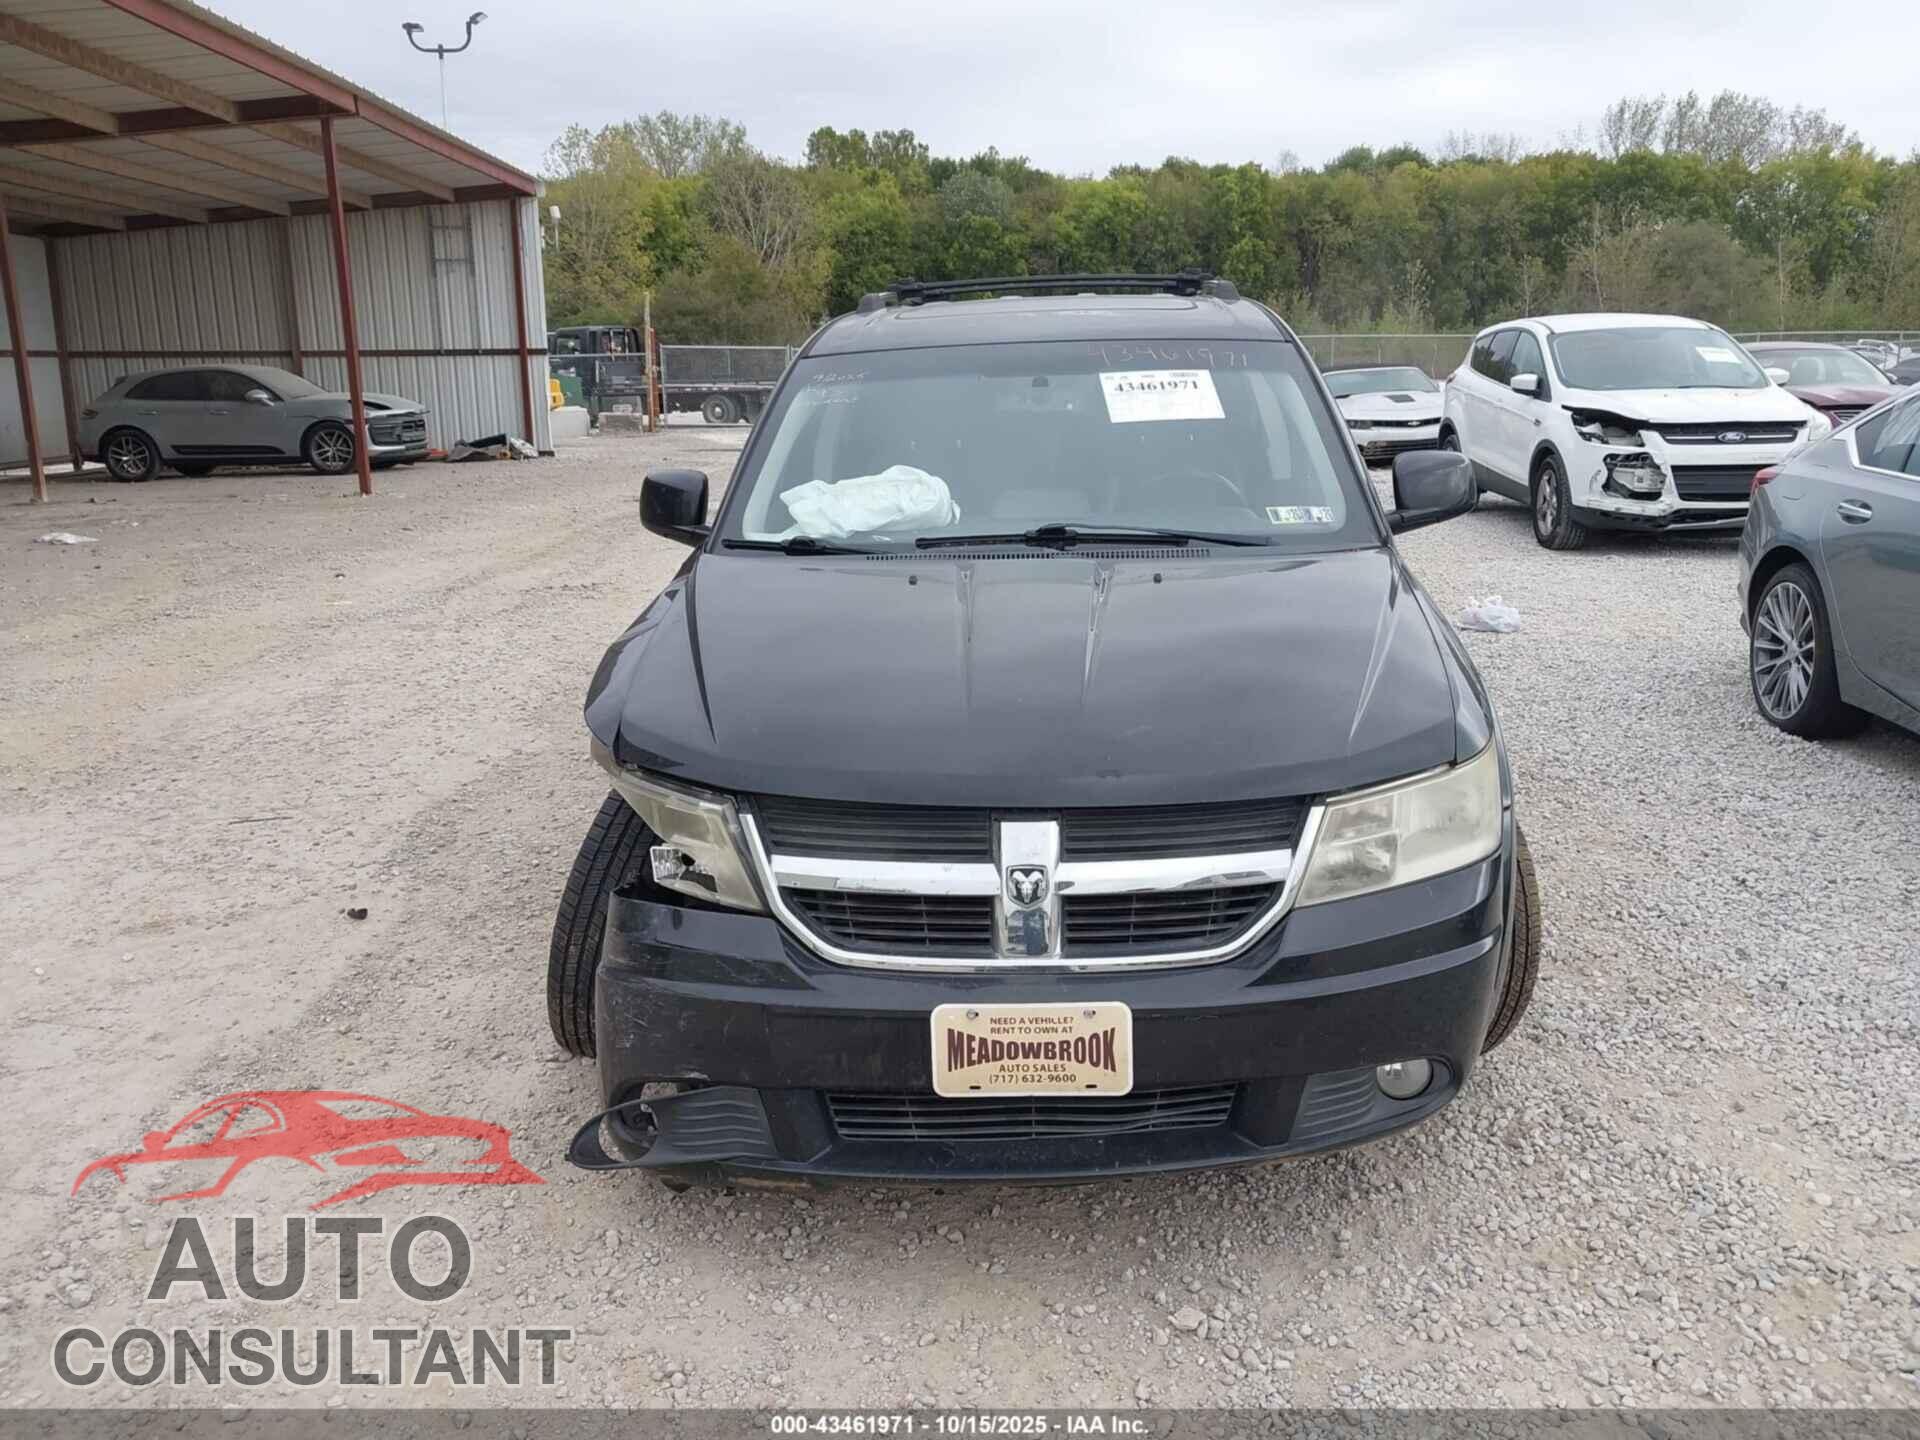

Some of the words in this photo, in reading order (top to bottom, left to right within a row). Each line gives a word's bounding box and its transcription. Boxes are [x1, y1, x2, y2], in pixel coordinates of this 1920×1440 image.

[1115, 380, 1198, 392] 43461971
[990, 1017, 1016, 1025] NEED
[1018, 1017, 1026, 1025] A
[990, 1027, 1016, 1035] RENT
[1034, 1026, 1058, 1034] OWN
[1061, 1026, 1073, 1034] AT
[947, 1027, 1116, 1073] MEADOWBROOK
[999, 1064, 1031, 1073] AUTO
[1032, 1064, 1067, 1072] SALES
[988, 1074, 1019, 1084] (717)
[1022, 1073, 1077, 1083] 632-9600
